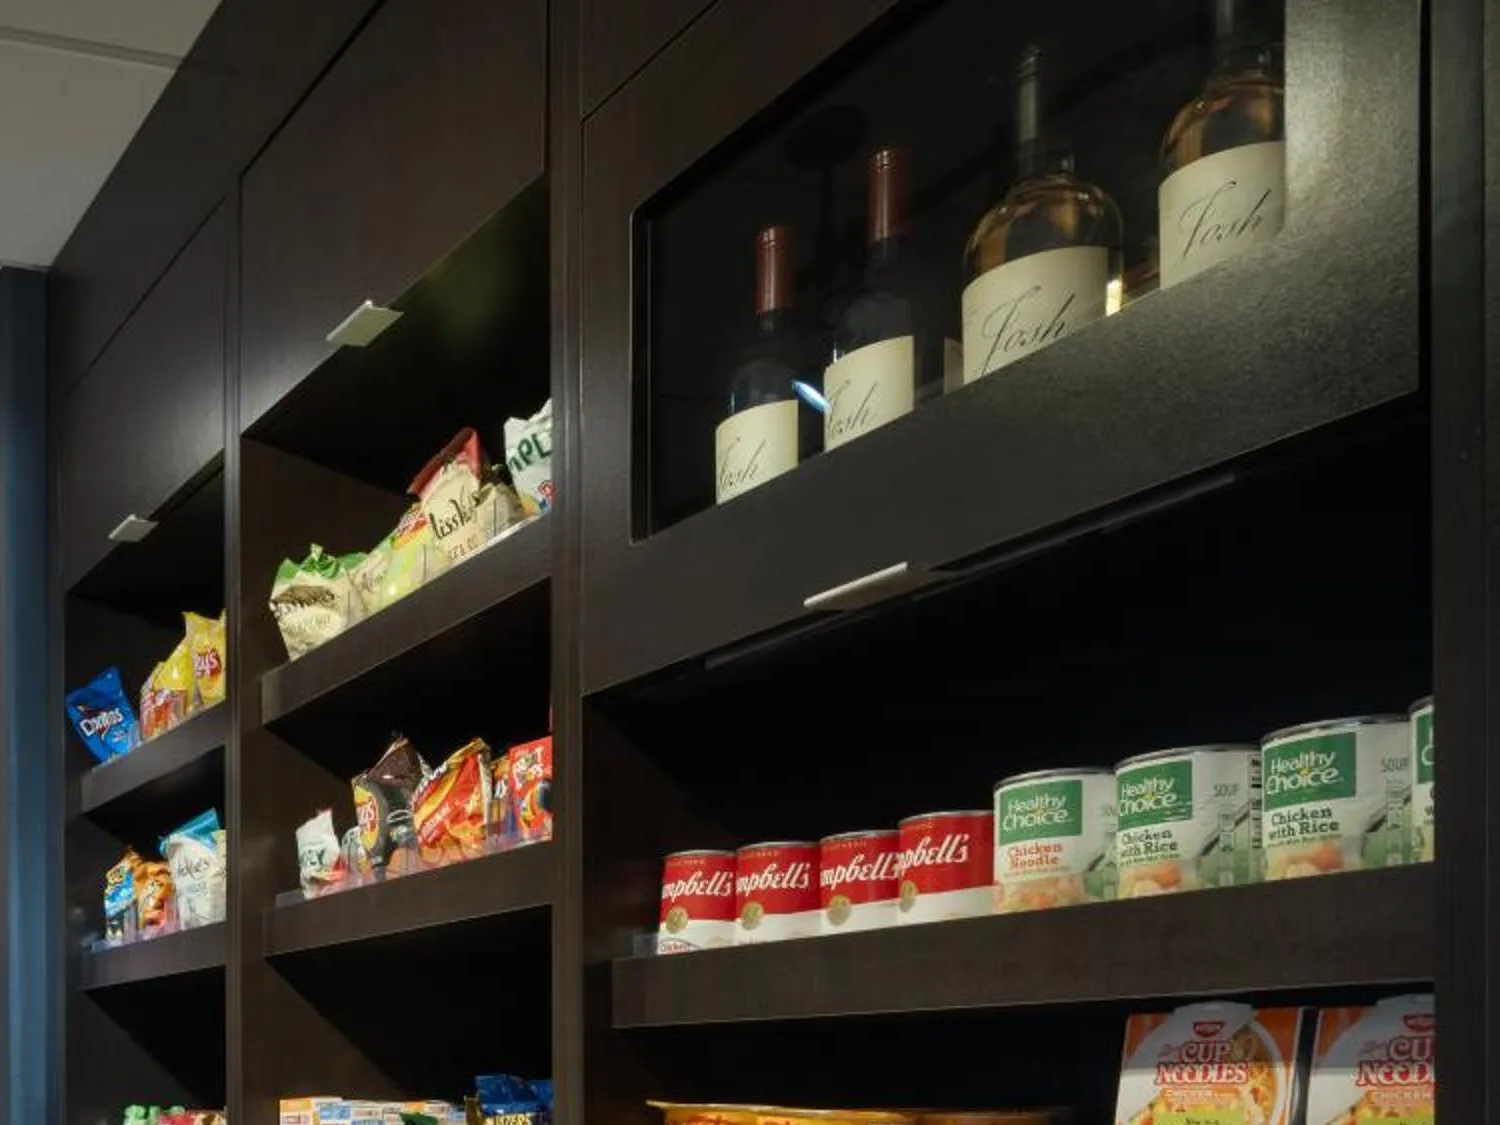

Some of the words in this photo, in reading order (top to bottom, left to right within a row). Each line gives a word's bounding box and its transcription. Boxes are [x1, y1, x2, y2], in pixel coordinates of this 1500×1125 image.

[1271, 751, 1336, 772] Healthy
[1122, 776, 1174, 795] Healthy
[1266, 766, 1340, 795] Choice
[1007, 793, 1067, 813] Healthy
[1002, 810, 1070, 832] Choice
[1271, 805, 1333, 827] Chicken
[1299, 819, 1340, 834] Rice
[1143, 840, 1179, 855] Rice
[1387, 1035, 1434, 1061] CU
[1156, 1060, 1250, 1086] NOODLES
[1356, 1060, 1434, 1086] NOOD
